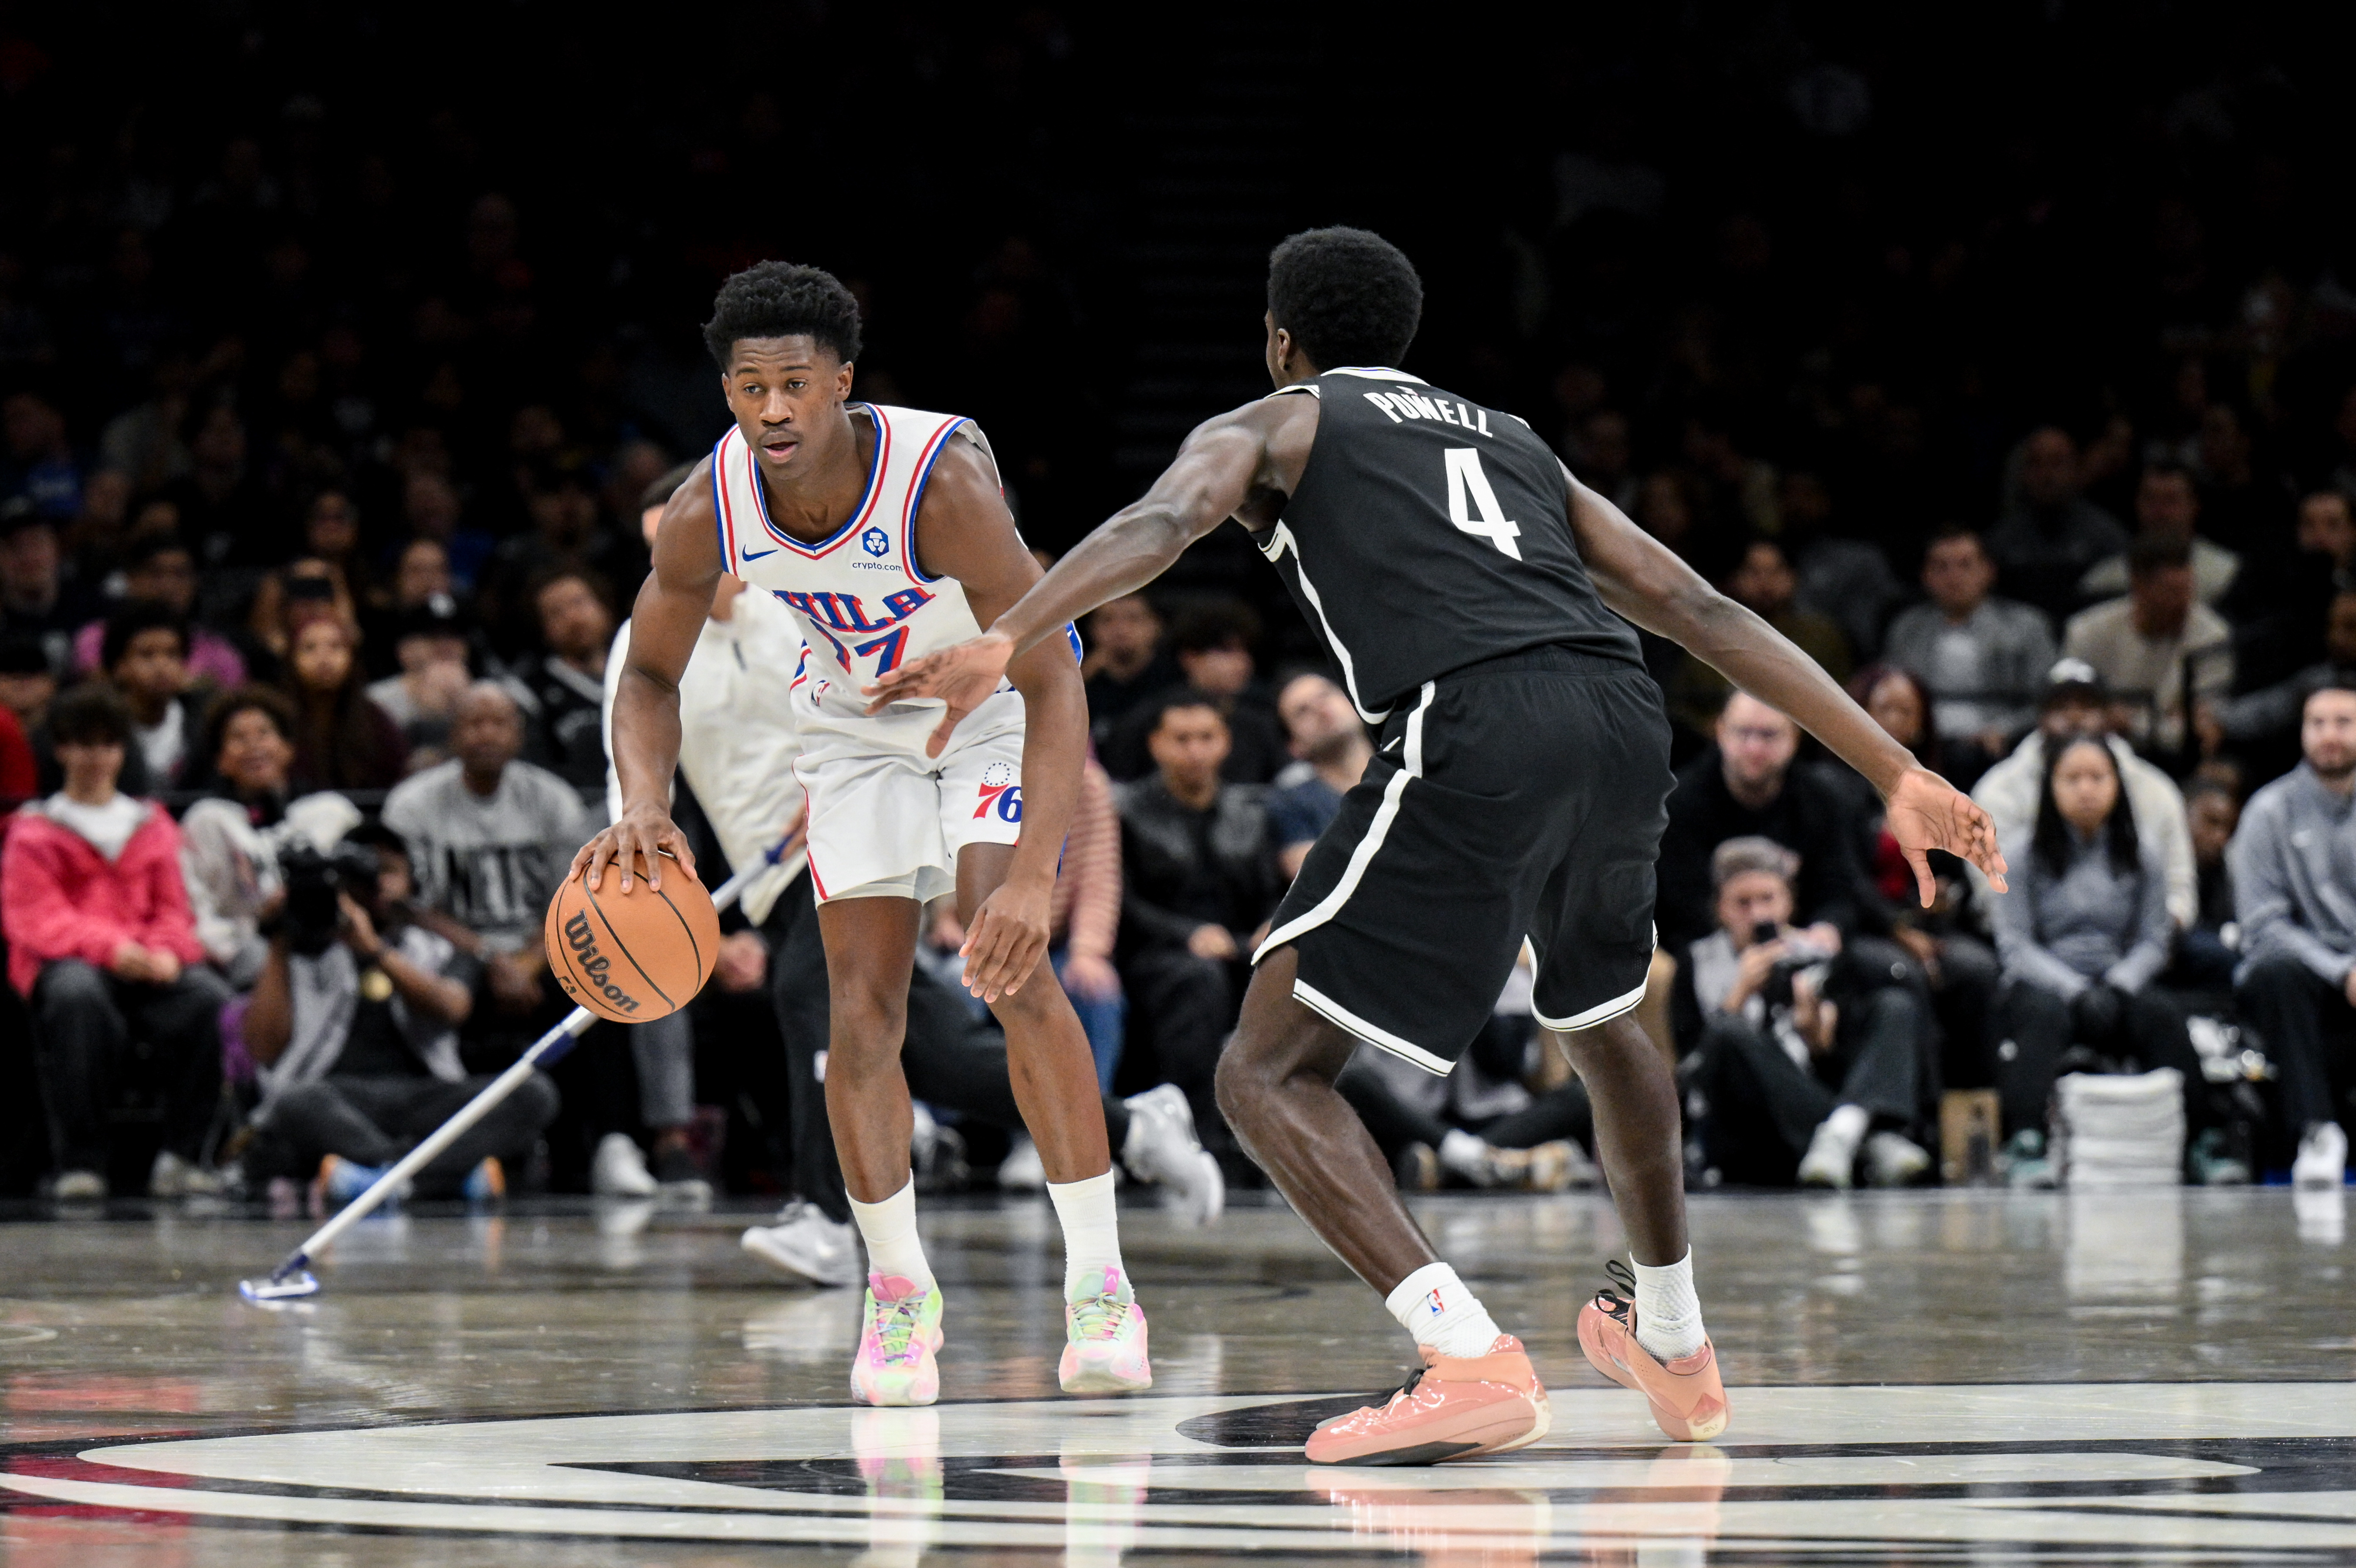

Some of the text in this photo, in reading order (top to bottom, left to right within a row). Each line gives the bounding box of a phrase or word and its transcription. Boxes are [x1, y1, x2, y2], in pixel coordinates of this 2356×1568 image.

[1363, 392, 1493, 438] POWELL
[1444, 448, 1522, 561] 4
[852, 562, 903, 572] crypto.com
[772, 587, 936, 634] HILA
[972, 782, 1022, 823] 76
[565, 908, 641, 1013] Wilson
